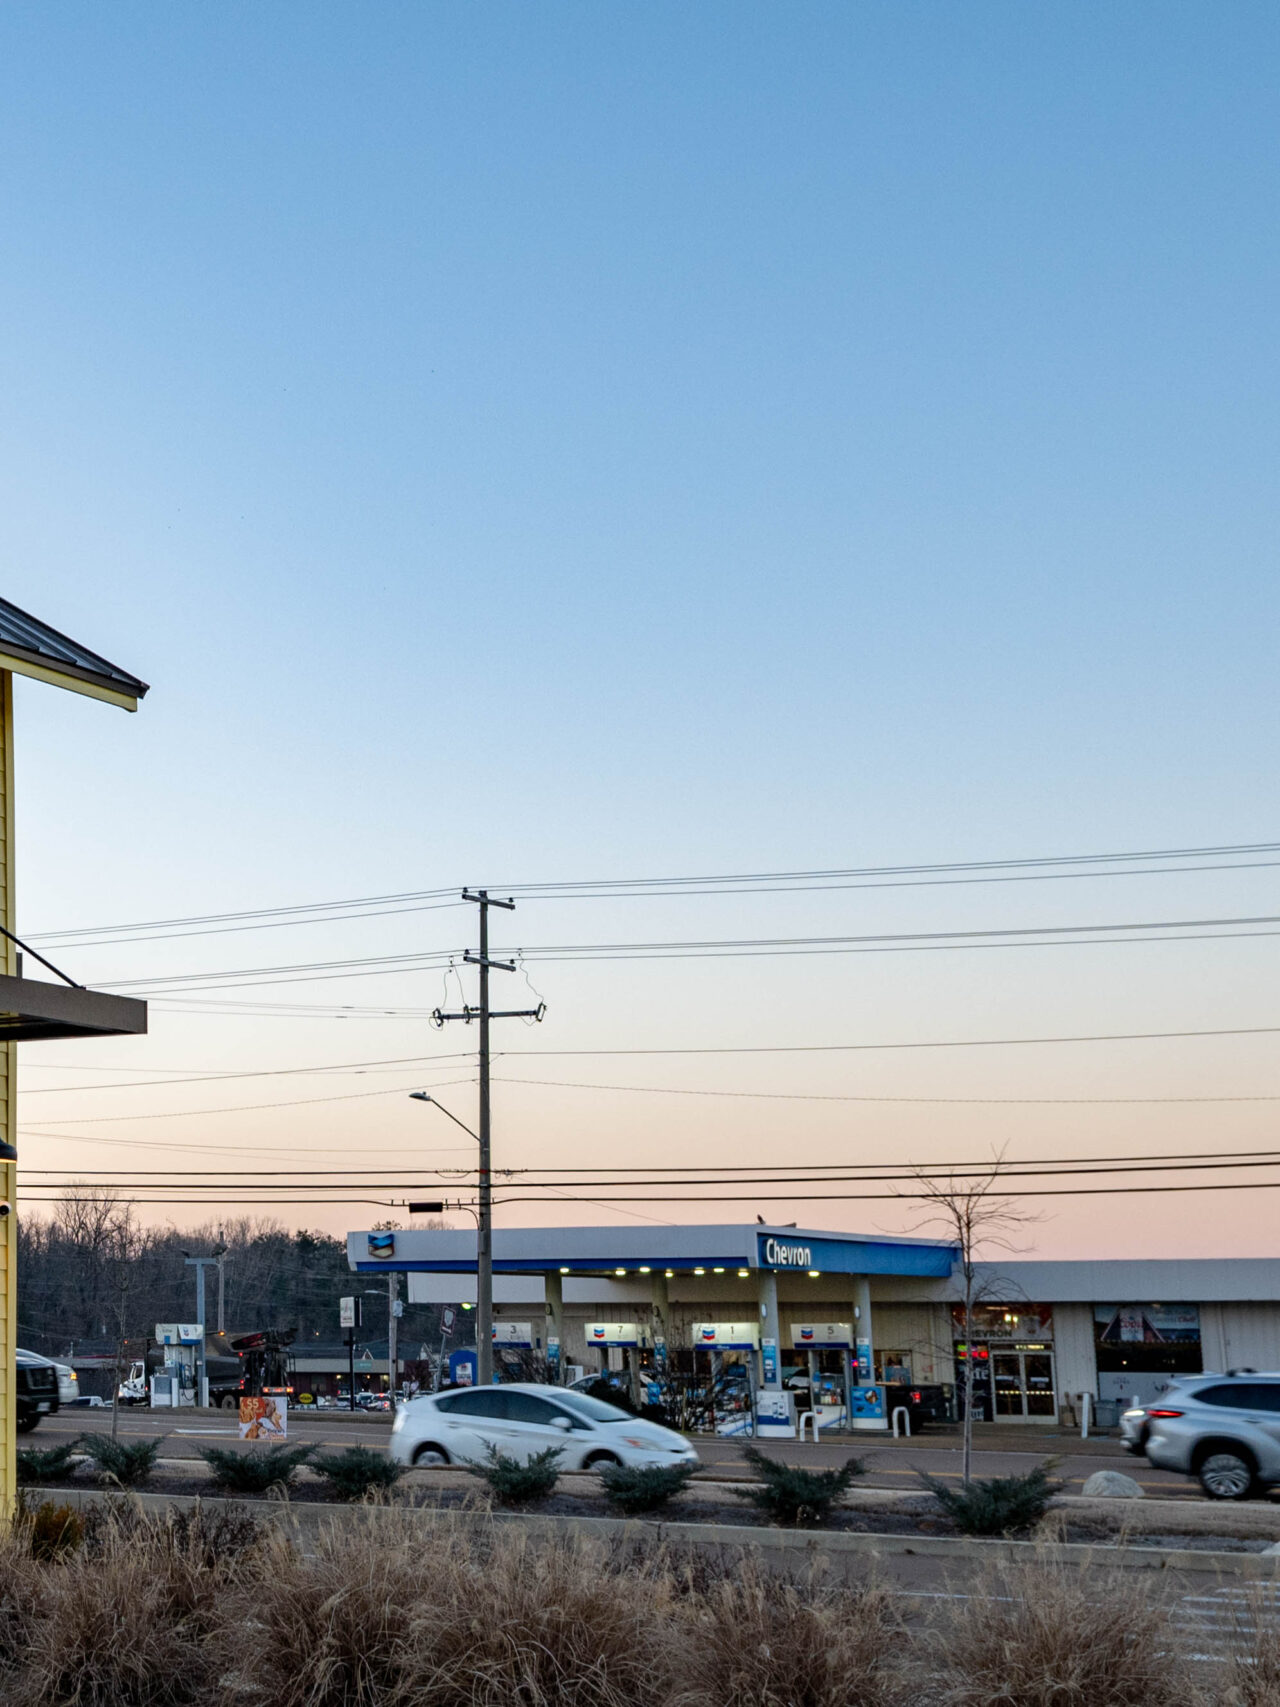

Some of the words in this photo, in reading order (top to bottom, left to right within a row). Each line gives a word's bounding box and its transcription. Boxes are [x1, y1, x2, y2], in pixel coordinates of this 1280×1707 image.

[766, 1238, 811, 1266] Chevron
[509, 1325, 517, 1334] 3
[617, 1325, 624, 1334] 7
[729, 1325, 735, 1335] 1
[827, 1325, 834, 1335] 5
